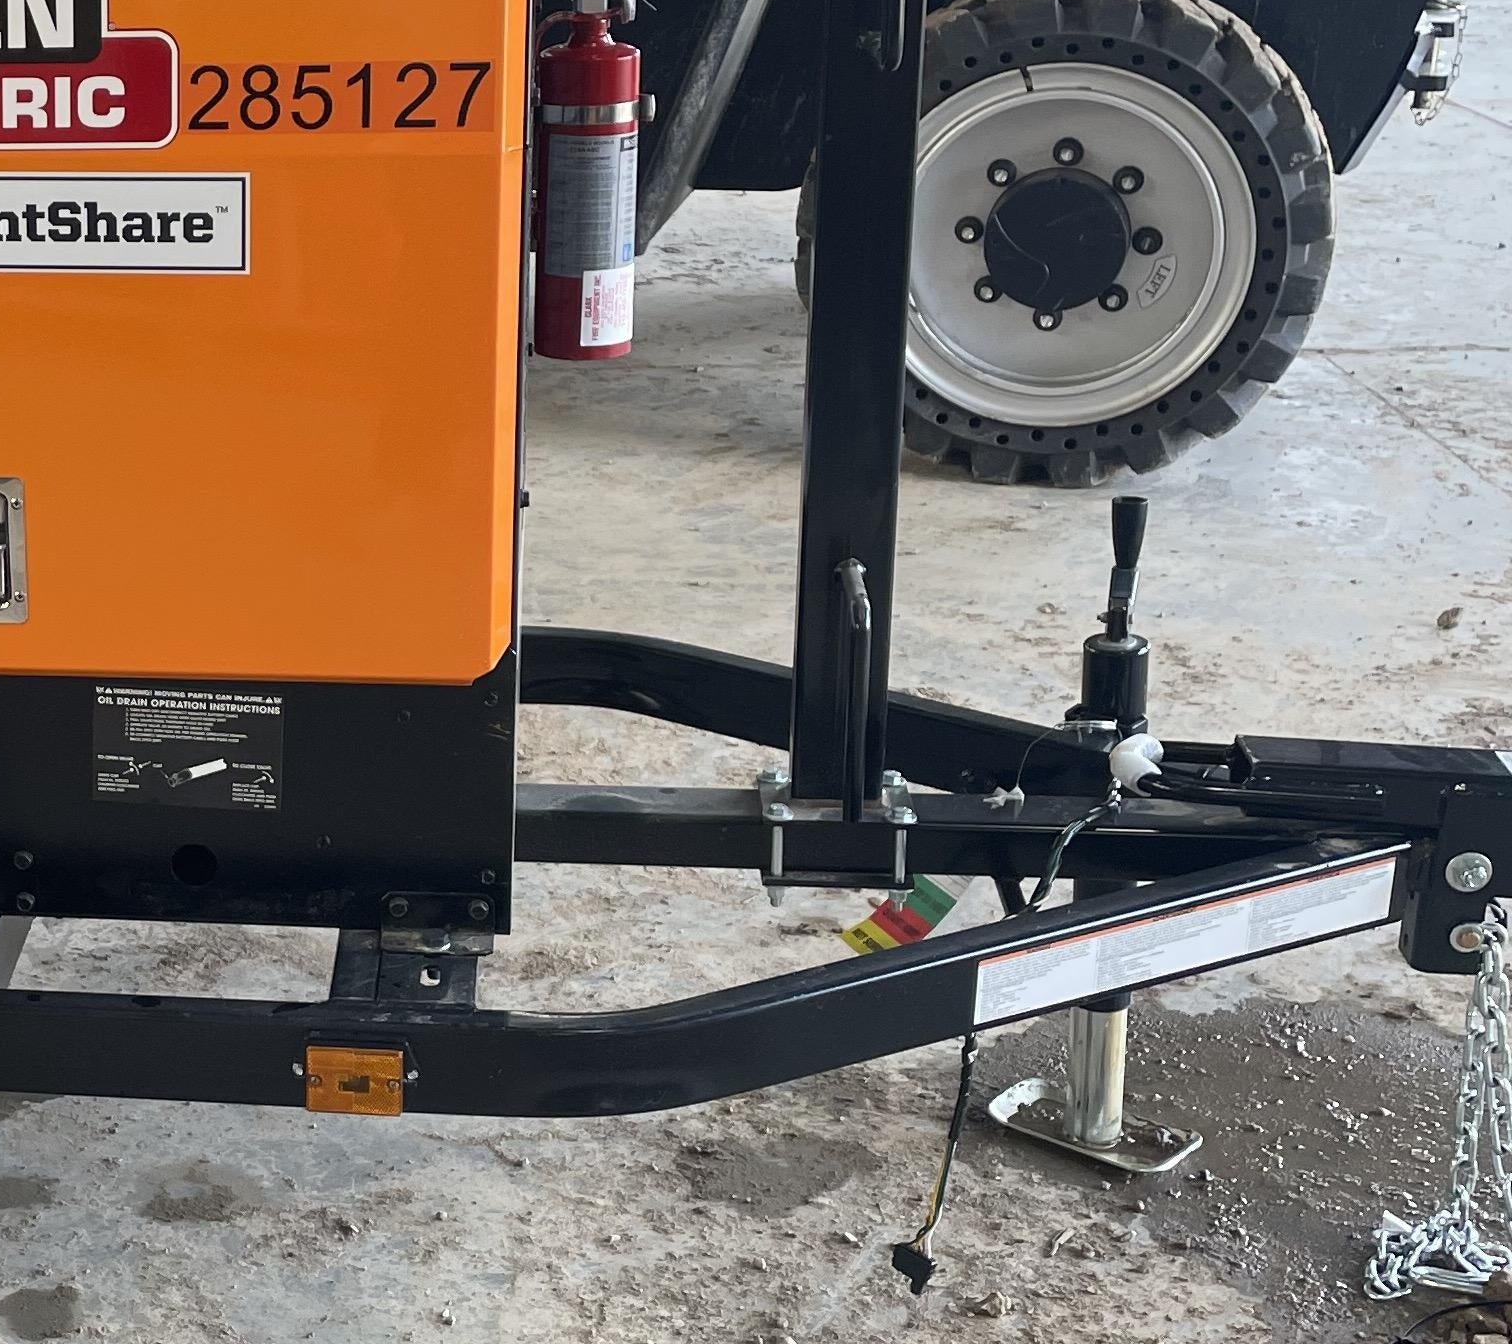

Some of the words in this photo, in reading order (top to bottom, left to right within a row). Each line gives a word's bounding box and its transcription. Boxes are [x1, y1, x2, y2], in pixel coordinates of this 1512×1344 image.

[187, 61, 493, 133] 285127
[1144, 262, 1172, 297] LEFT
[97, 695, 114, 705] OIL
[116, 696, 148, 706] DRAIN
[150, 698, 207, 710] OPERATION
[209, 702, 281, 715] INSTRUCTIONS
[187, 692, 213, 700] PARTS
[215, 693, 233, 701] CAN
